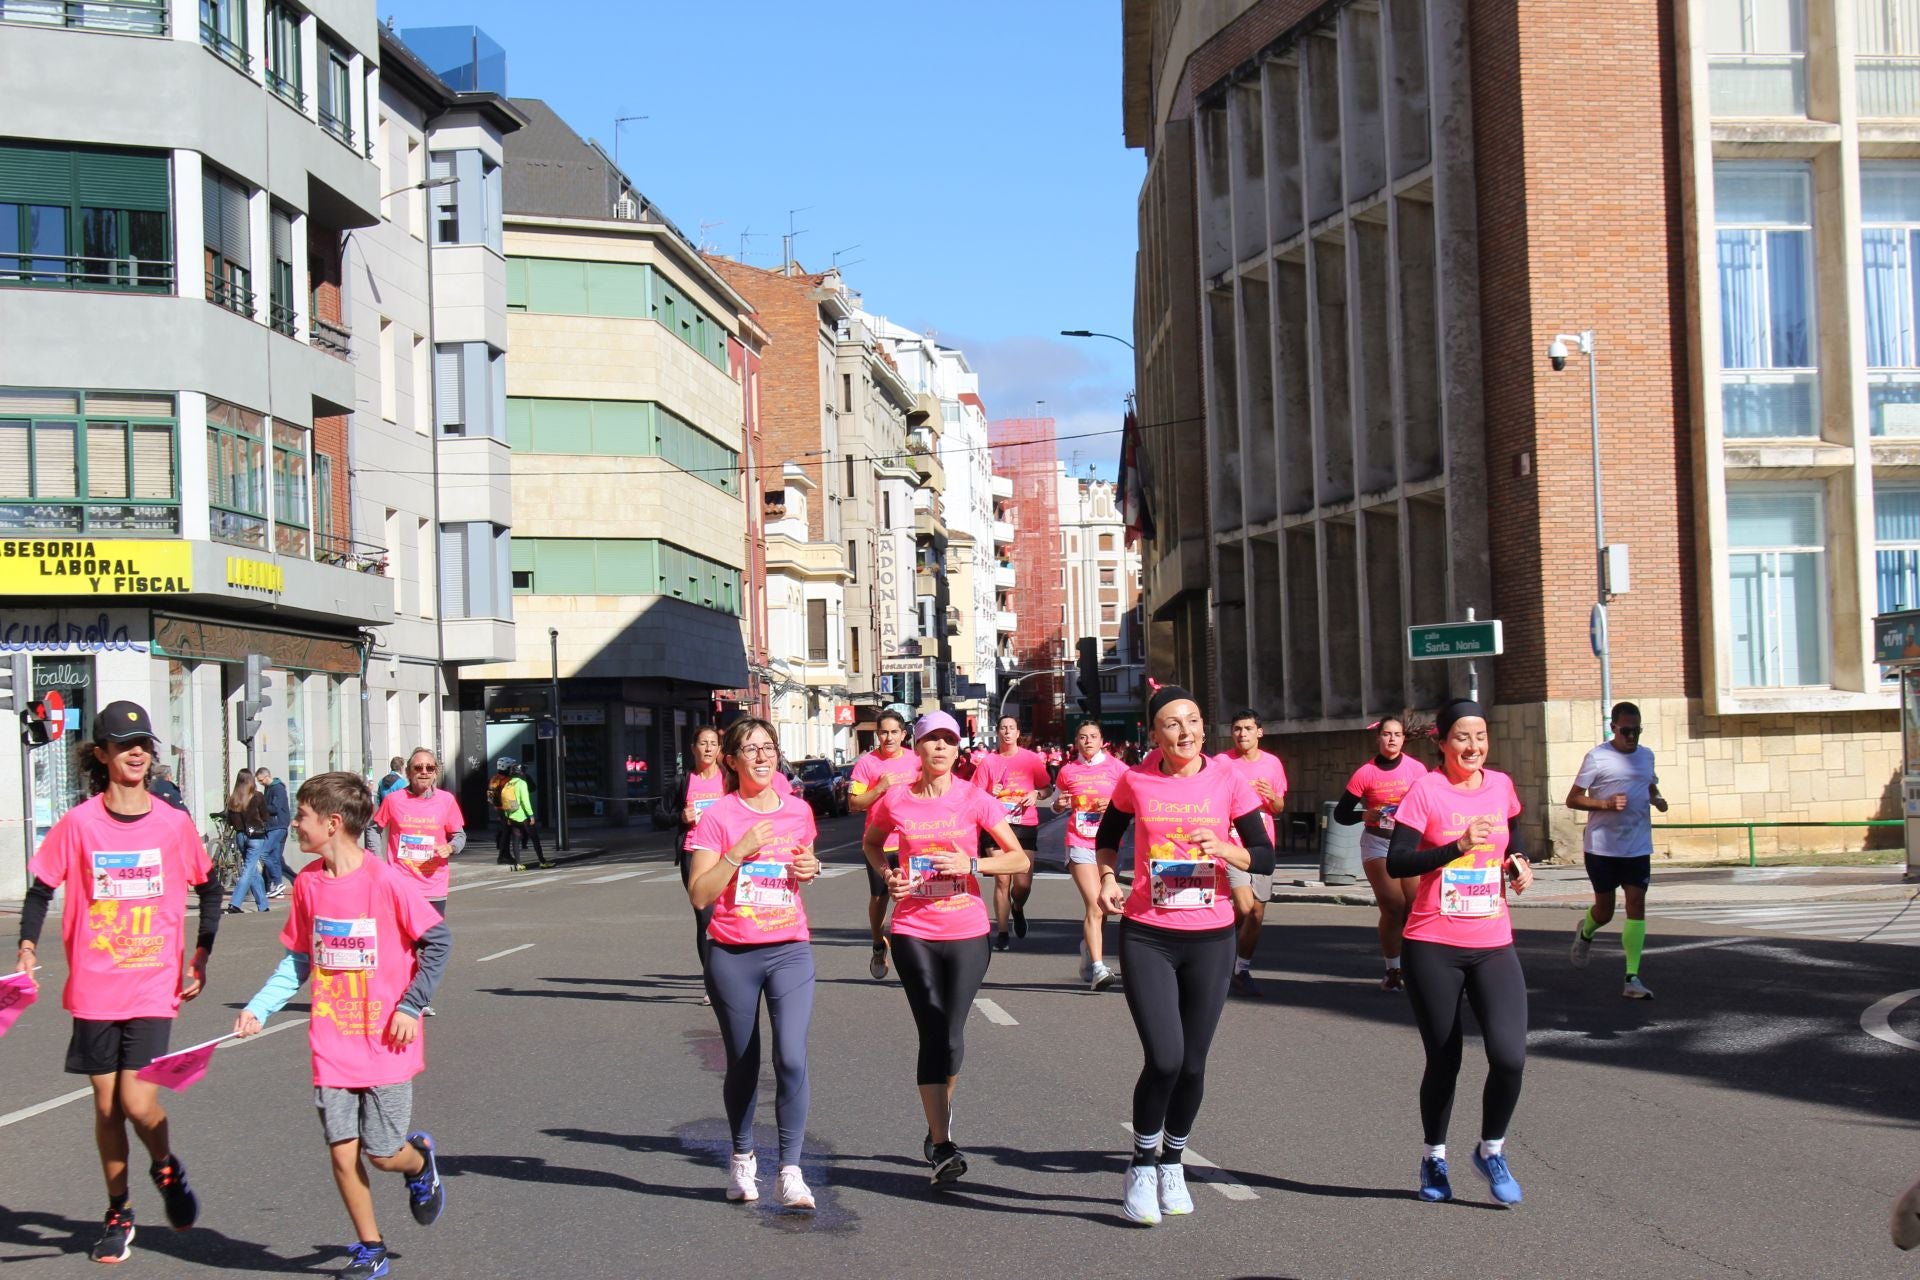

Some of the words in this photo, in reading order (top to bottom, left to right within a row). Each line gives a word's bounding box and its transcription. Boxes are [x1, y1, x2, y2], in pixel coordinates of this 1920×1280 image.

[0, 541, 96, 558] SESORIA
[39, 559, 140, 576] LABORAL
[88, 577, 101, 592] Y
[114, 577, 191, 593] FISCAL
[879, 540, 897, 653] ADONIAS
[1425, 642, 1451, 653] Santa
[882, 662, 923, 671] restaurante
[1148, 798, 1211, 814] Drasanvi
[117, 867, 152, 880] 4345
[1174, 877, 1202, 888] 1270
[1467, 884, 1491, 896] 1224
[115, 935, 165, 947] Carrera
[331, 937, 366, 949] 4496
[335, 999, 383, 1011] Carrra
